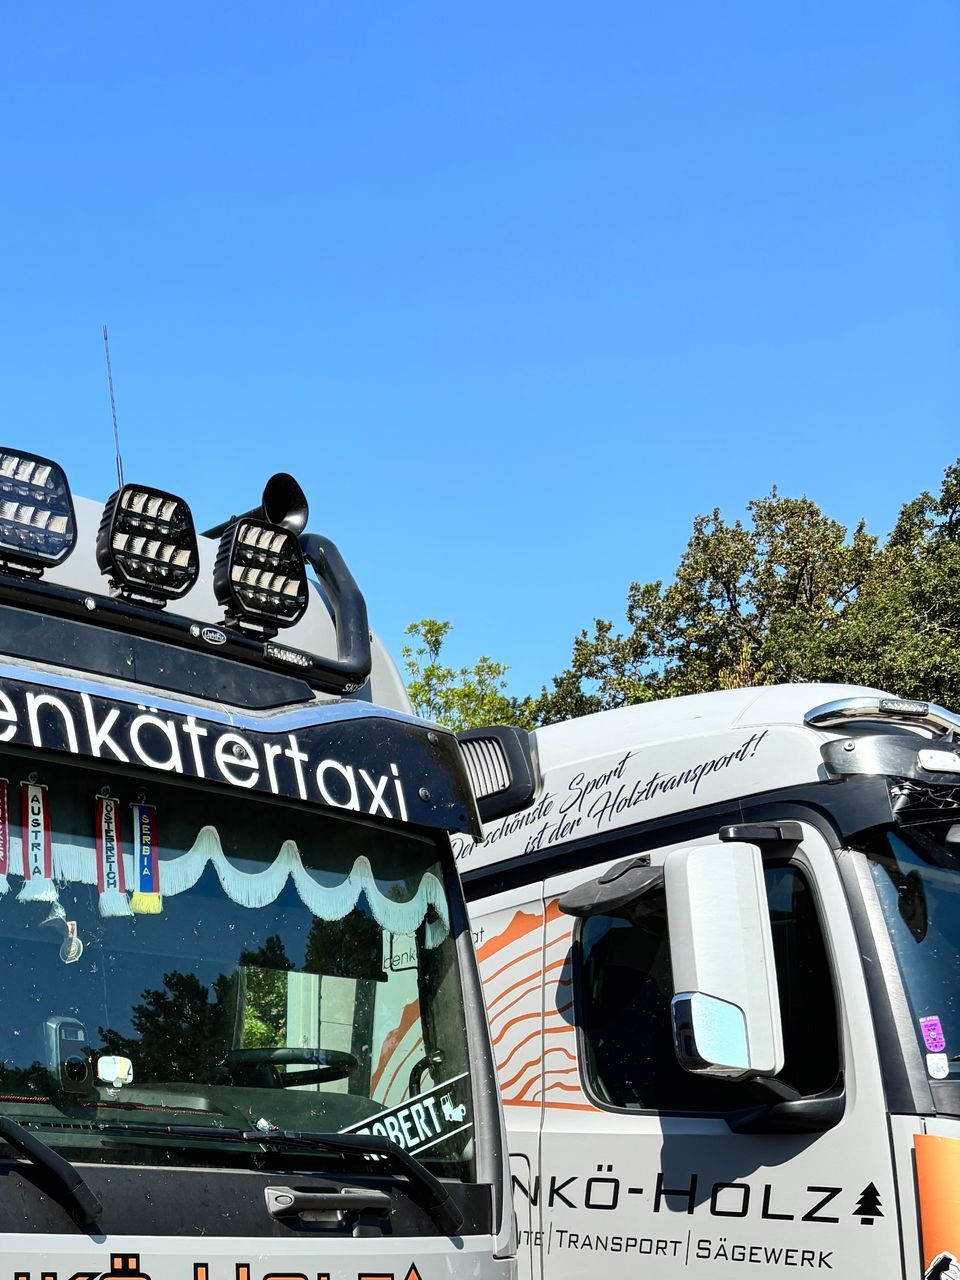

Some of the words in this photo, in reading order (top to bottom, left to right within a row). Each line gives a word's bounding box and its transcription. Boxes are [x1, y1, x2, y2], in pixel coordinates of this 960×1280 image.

[30, 794, 43, 876] AUSTRIA
[483, 791, 559, 849] schönste
[560, 750, 642, 815] Sport
[524, 822, 552, 855] ist
[548, 813, 583, 846] der
[588, 730, 770, 829] Holztransport!
[104, 800, 117, 889] ÖSTERREICH
[141, 815, 151, 876] SERBIA
